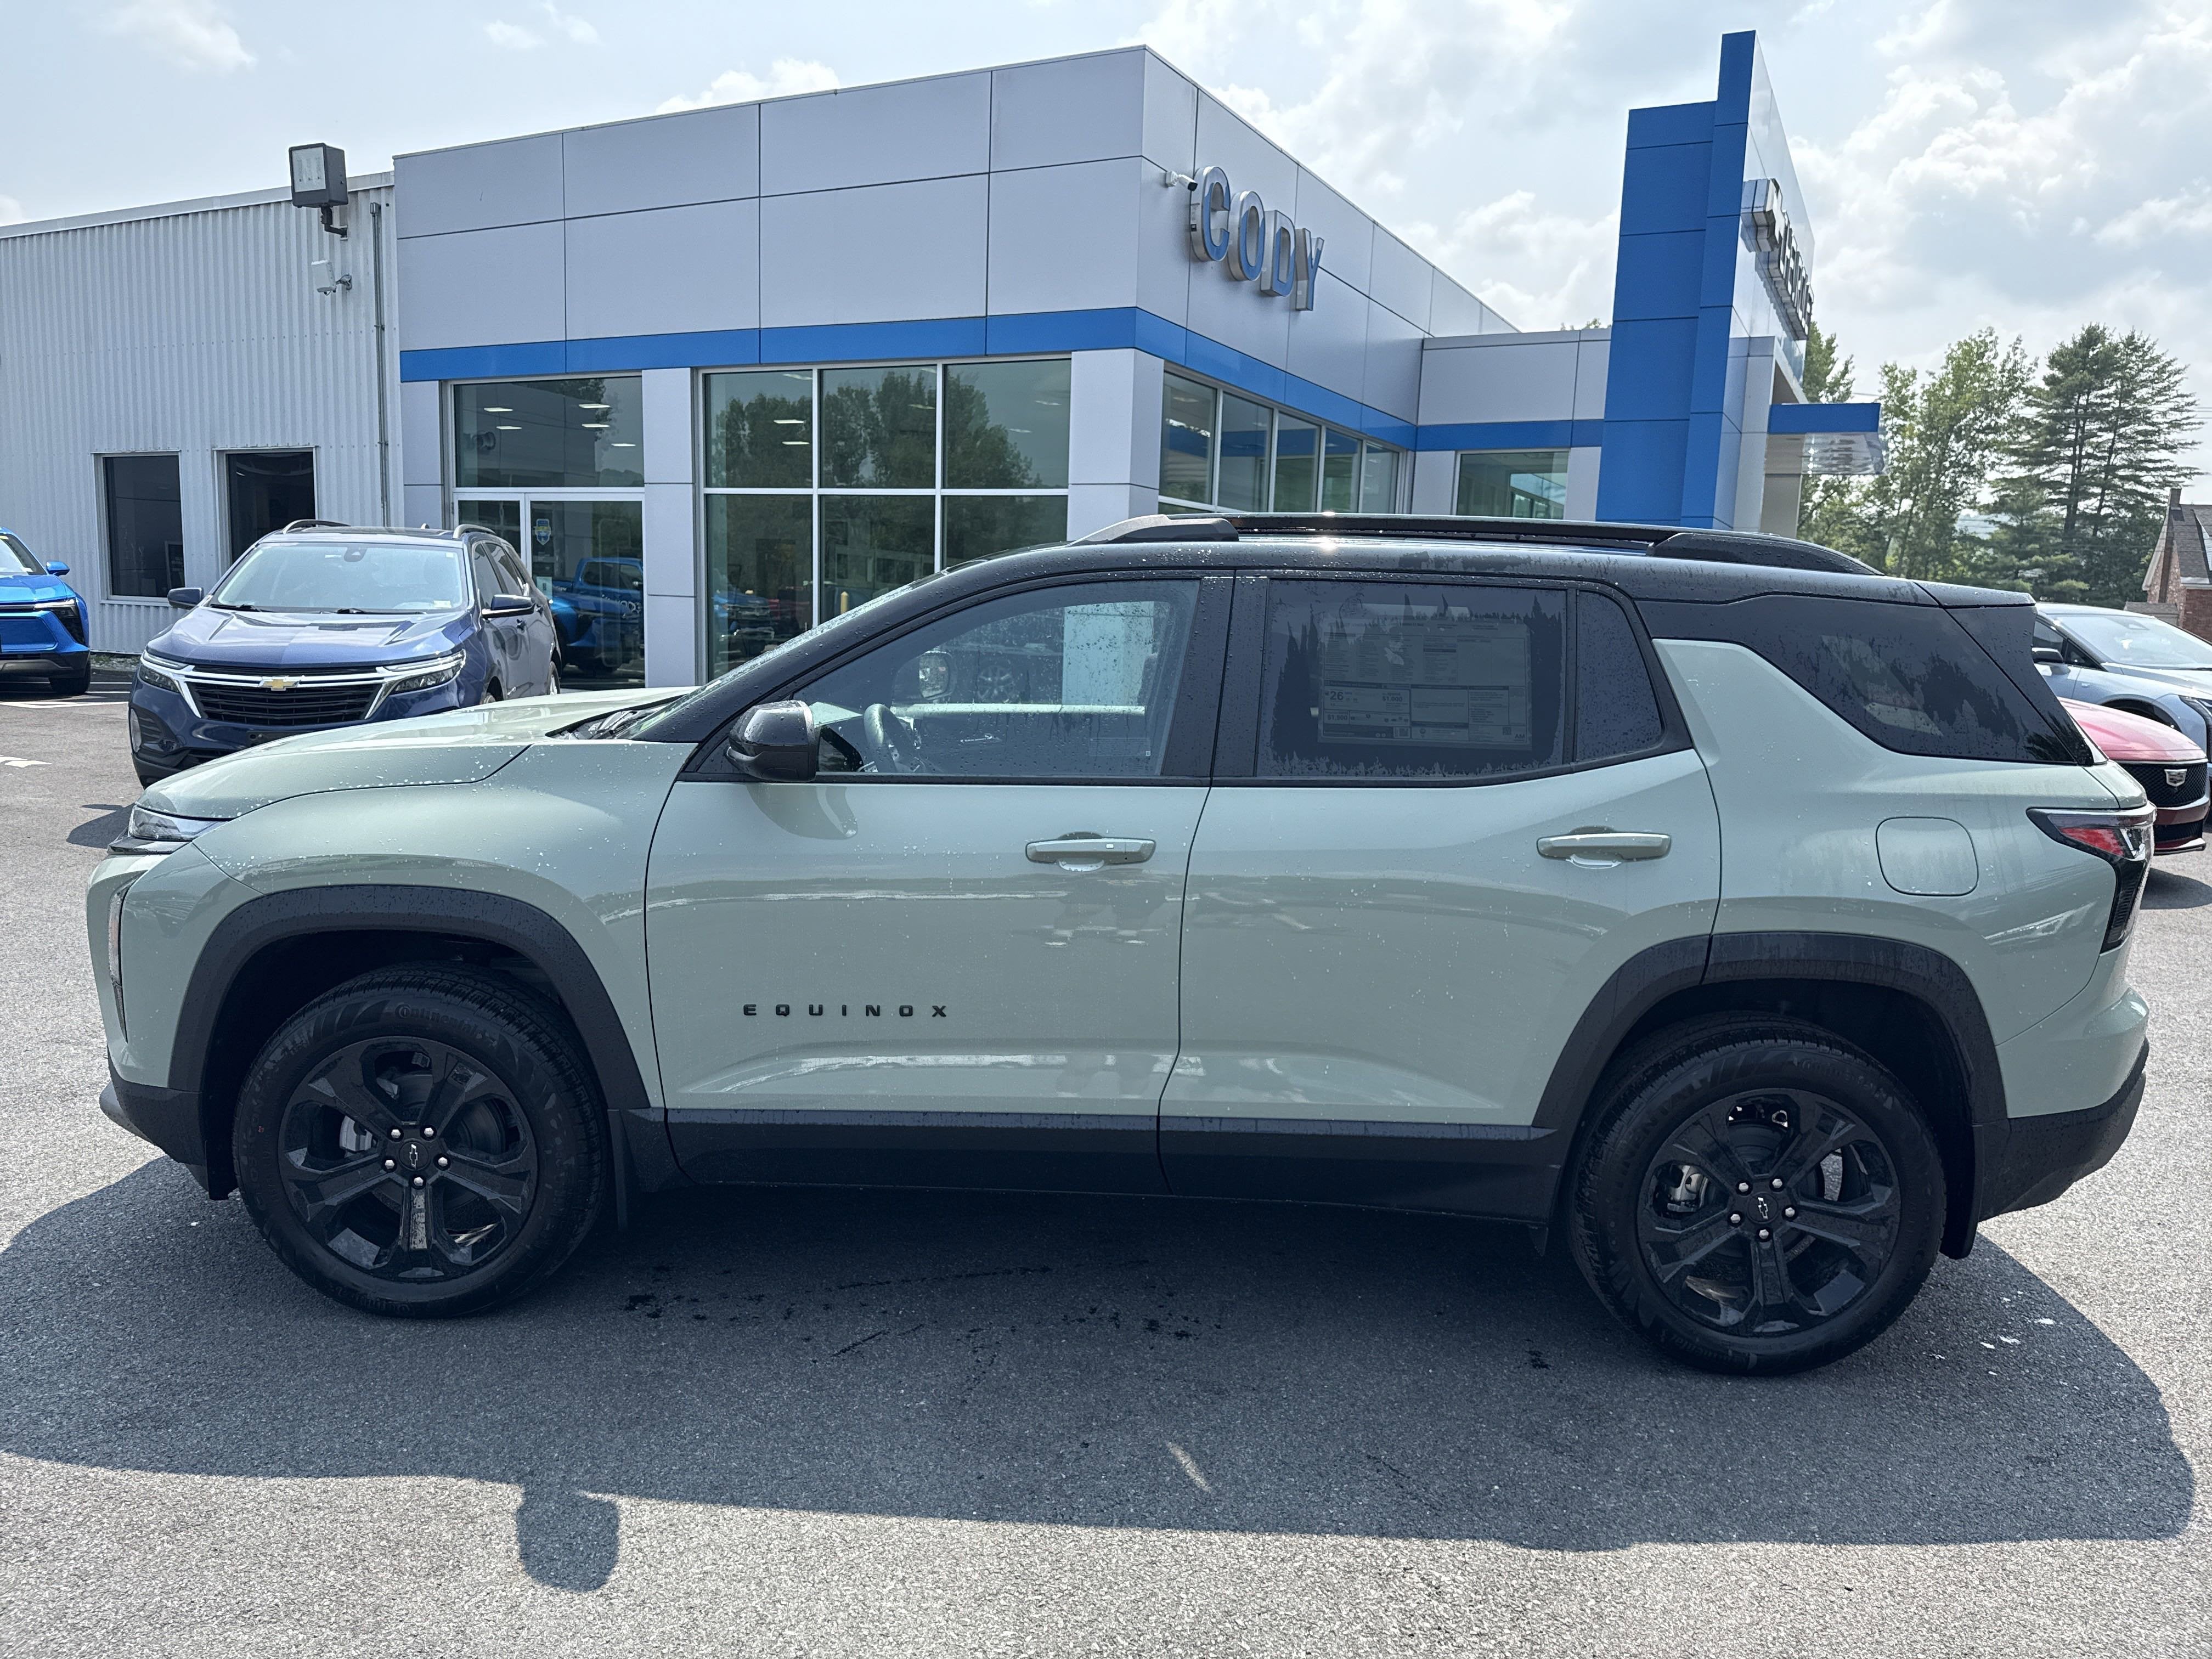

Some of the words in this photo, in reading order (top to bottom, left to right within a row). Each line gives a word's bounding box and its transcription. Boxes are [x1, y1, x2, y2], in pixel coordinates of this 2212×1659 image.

[1192, 166, 1324, 311] CODY
[1329, 691, 1344, 701] 26
[743, 1003, 947, 1018] EQUINOX
